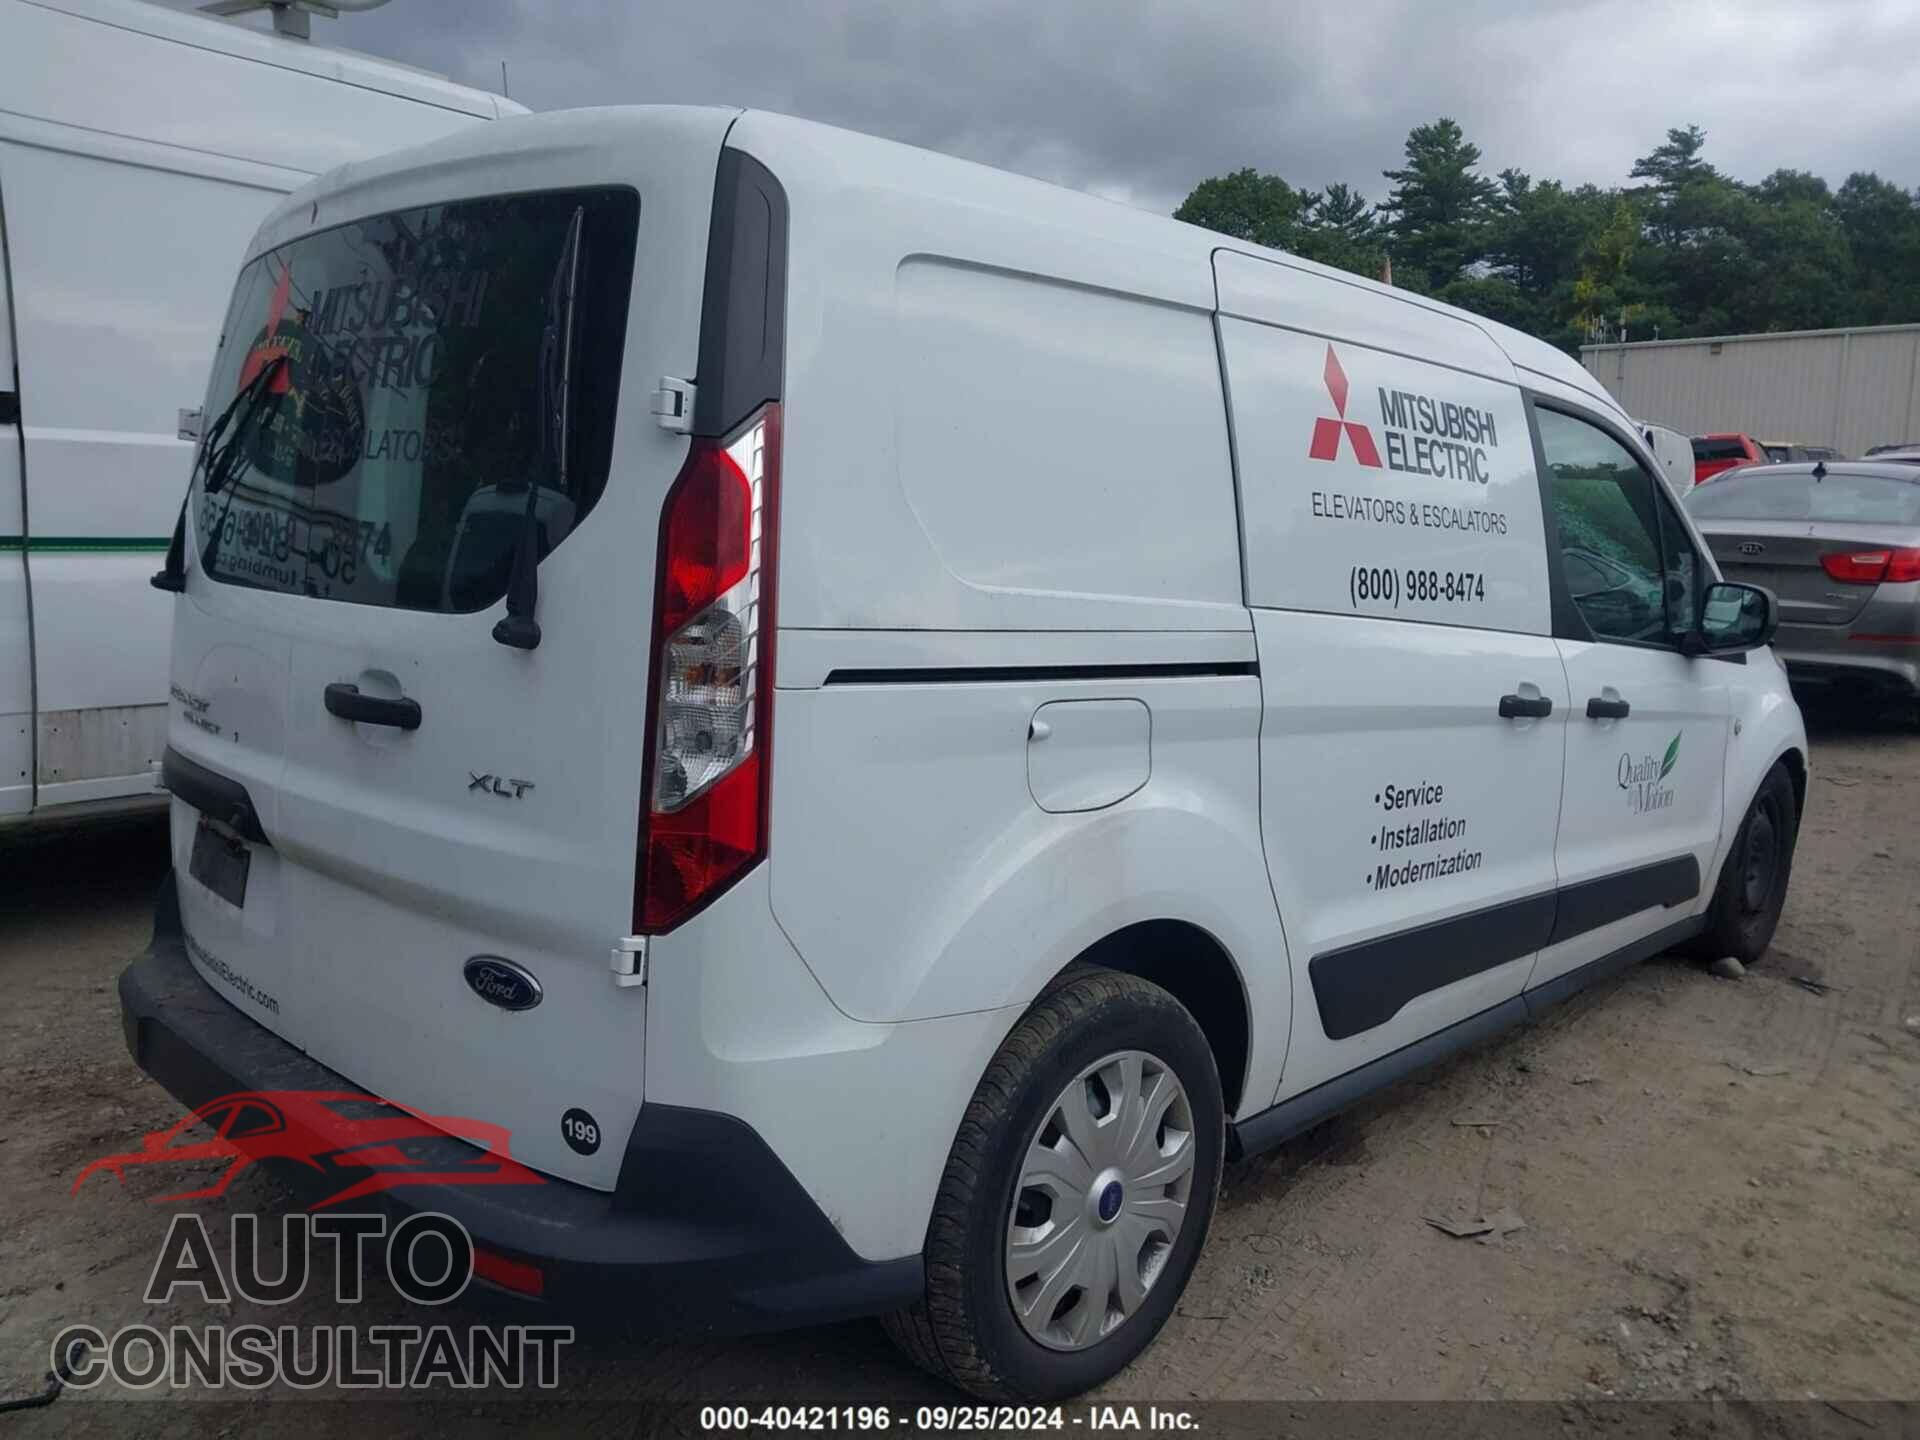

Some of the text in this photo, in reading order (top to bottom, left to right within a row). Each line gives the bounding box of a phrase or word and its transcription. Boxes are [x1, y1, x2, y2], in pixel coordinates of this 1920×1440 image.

[304, 333, 441, 389] ECTRIC
[1378, 386, 1497, 447] MITSUBISHI
[1385, 431, 1489, 484] ELECTRIC
[1312, 491, 1507, 534] ELEVATORS & ESCALATORS
[1350, 566, 1484, 608] (800) 988-8474
[468, 770, 536, 800] XLT
[1617, 752, 1663, 790] Quality
[1383, 780, 1444, 811] Service
[1380, 816, 1466, 852] Installation
[1374, 848, 1482, 892] Modernization
[474, 967, 521, 1001] Ford
[564, 1117, 598, 1145] 199
